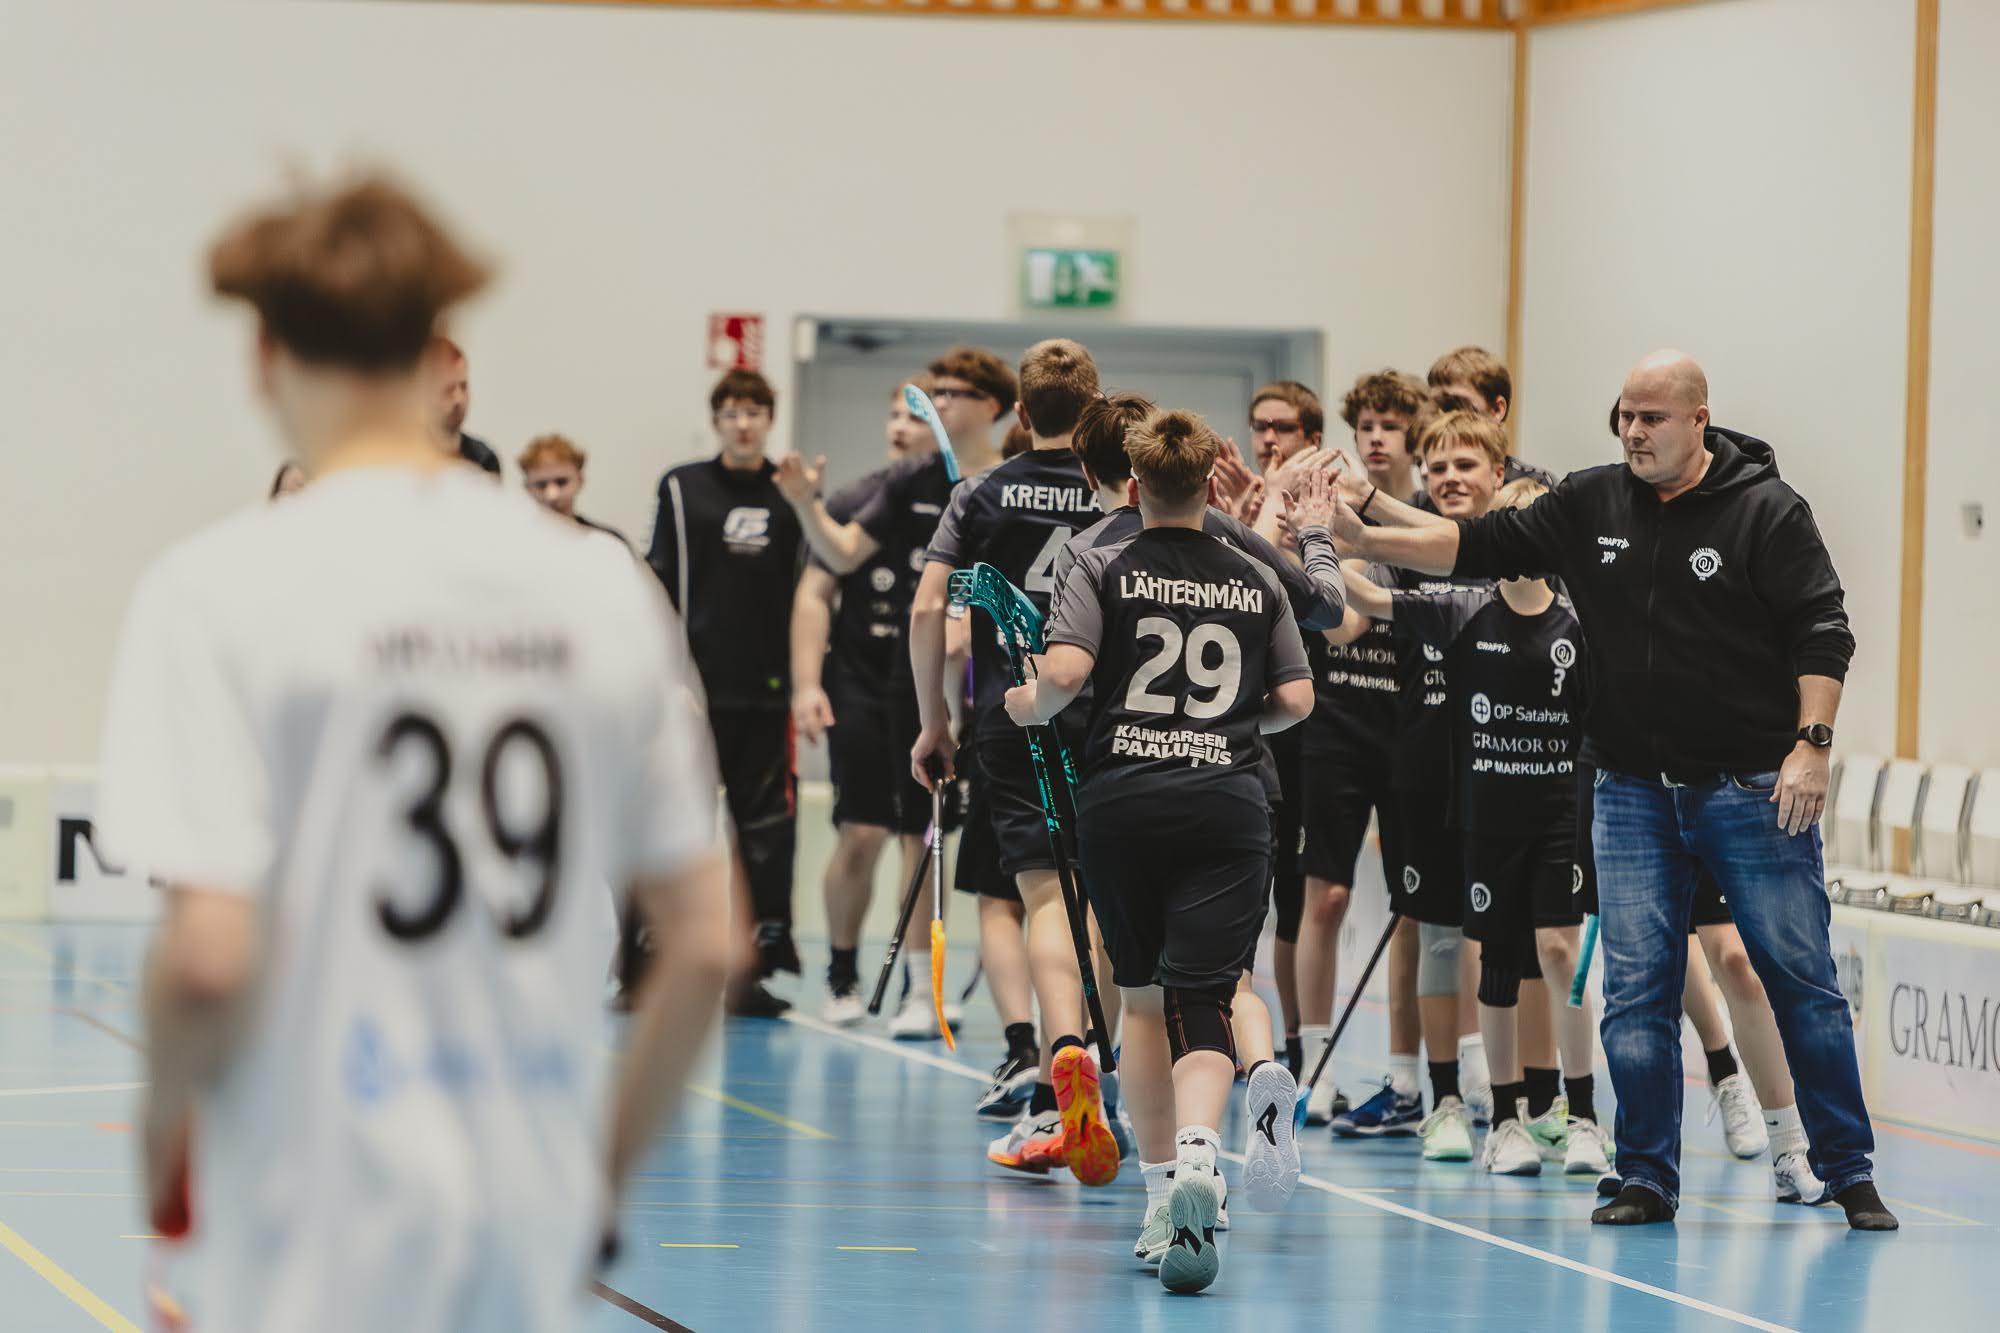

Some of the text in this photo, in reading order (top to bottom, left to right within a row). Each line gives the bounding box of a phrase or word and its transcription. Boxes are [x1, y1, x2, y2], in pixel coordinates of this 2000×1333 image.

[1025, 526, 1072, 599] 4
[1601, 551, 1616, 563] JPP
[1120, 571, 1263, 614] LÄHTEENMÄKI
[1124, 616, 1242, 719] 29
[1551, 667, 1567, 697] 3
[1493, 704, 1513, 720] OP
[1115, 725, 1228, 750] KANKAREEN
[1473, 732, 1569, 753] GRAMOR OY
[1494, 760, 1555, 775] MARKULA
[1557, 760, 1573, 773] OY
[374, 711, 565, 943] 39
[1890, 982, 2000, 1073] GRAM
